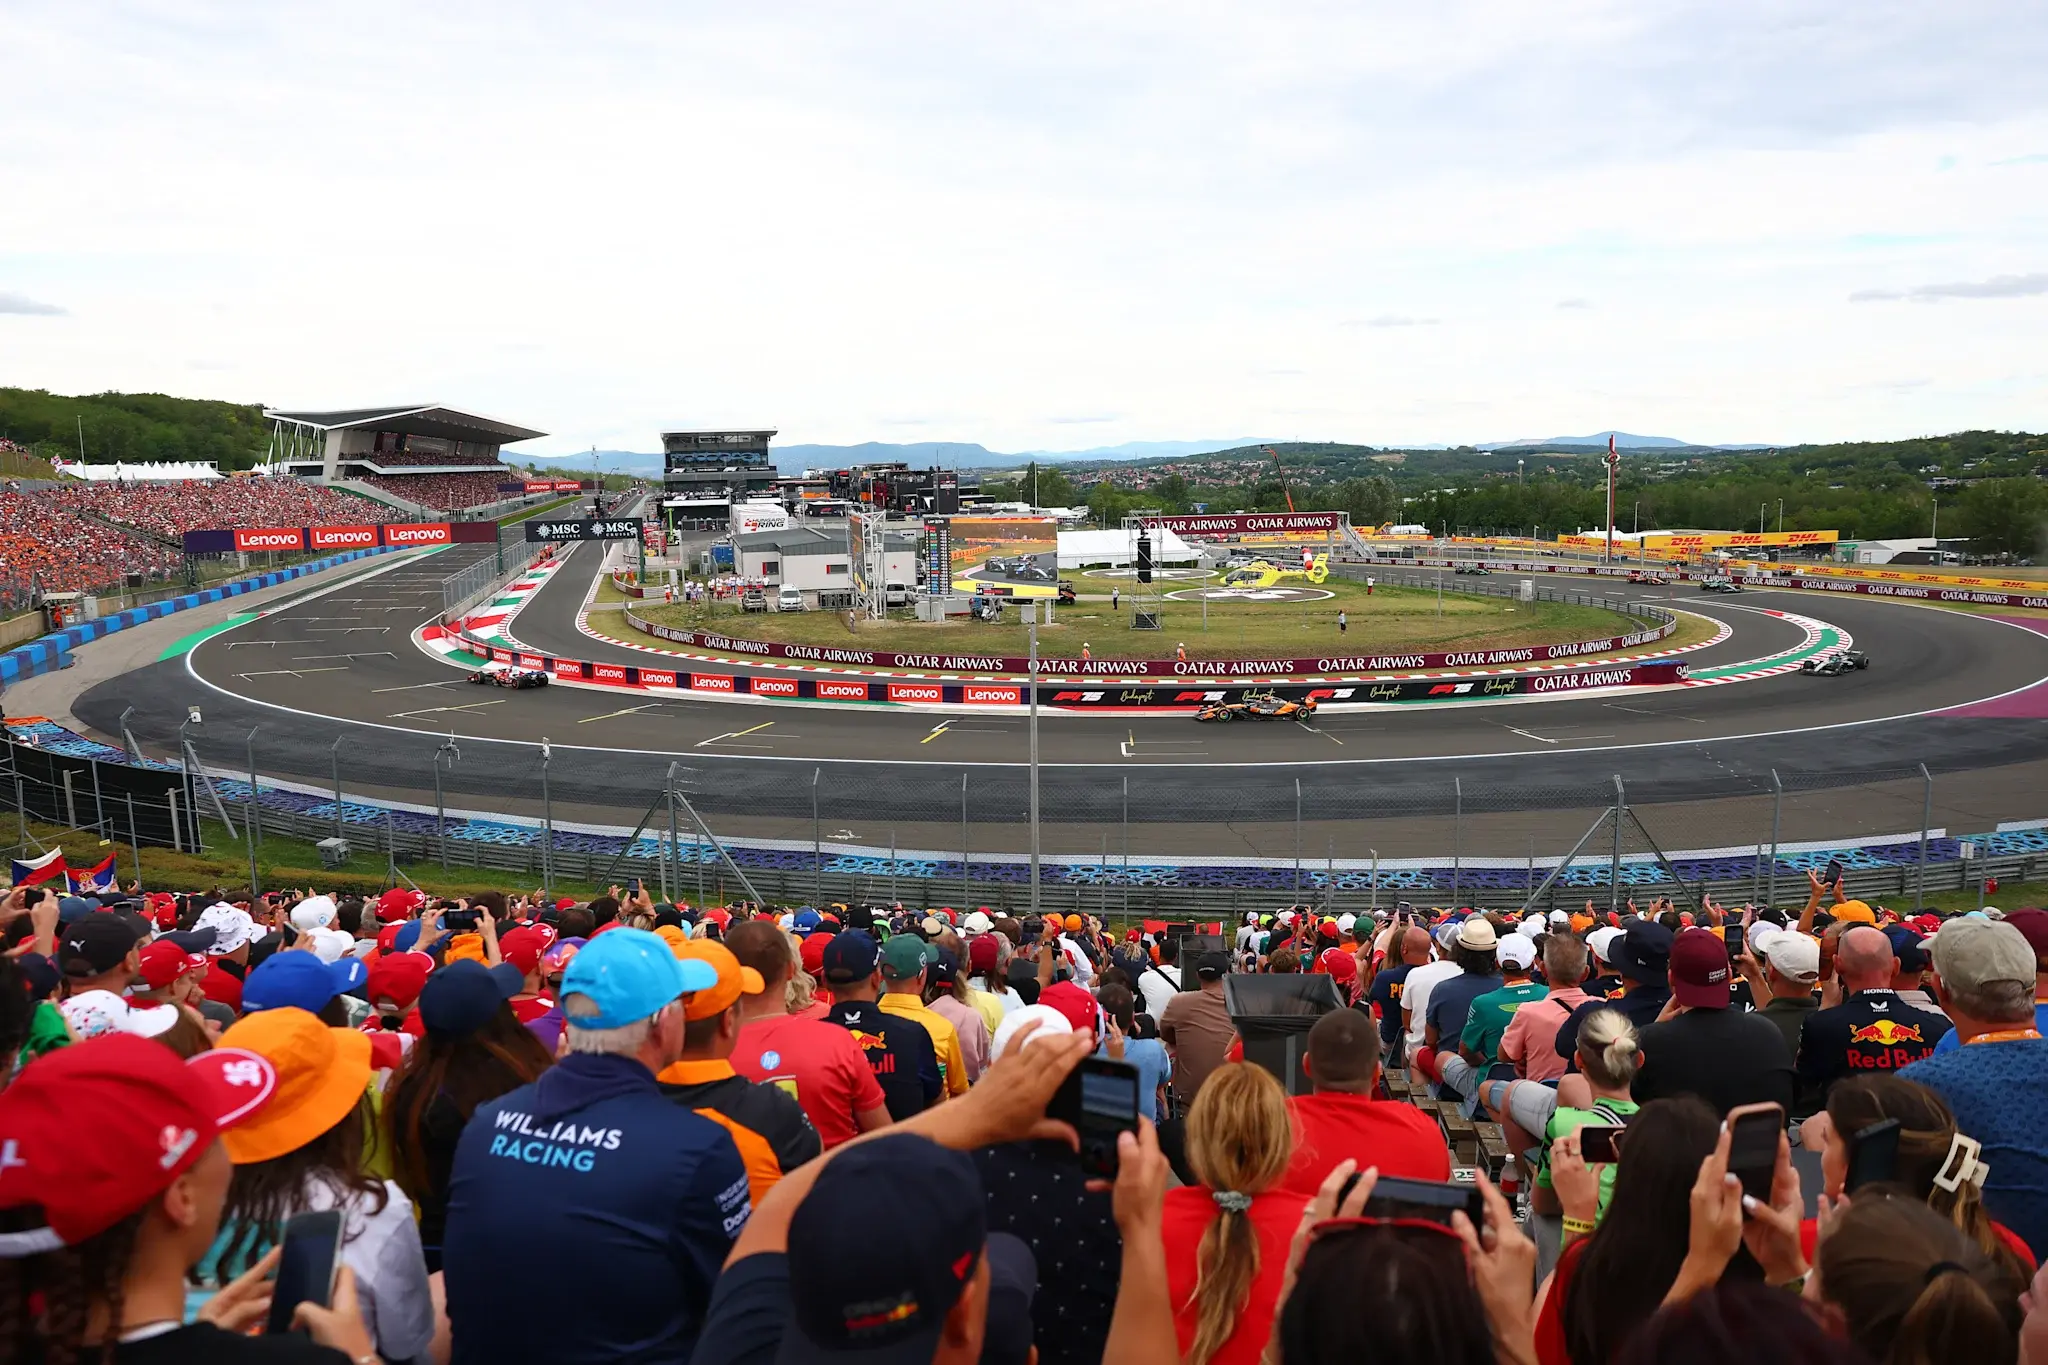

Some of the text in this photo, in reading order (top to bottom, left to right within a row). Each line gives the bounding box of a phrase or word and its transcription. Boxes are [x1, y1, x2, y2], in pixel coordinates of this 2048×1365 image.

[526, 483, 550, 491] Lenovo
[555, 482, 579, 490] Lenovo
[551, 523, 580, 534] MSC
[605, 521, 634, 533] MSC
[1149, 519, 1237, 531] QATAR AIRWAYS
[1246, 516, 1332, 530] QATAR AIRWAYS
[240, 533, 298, 546] Lenovo
[315, 531, 373, 544] Lenovo
[389, 528, 446, 542] Lenovo
[1566, 537, 1587, 545] DHL
[1671, 537, 1704, 546] DHL
[1730, 535, 1762, 545] DHL
[1788, 533, 1819, 542] DHL
[1742, 576, 1792, 587] QATAR AIRWAYS
[1801, 580, 1857, 592] QATAR AIRWAYS
[1868, 585, 1928, 598] QATAR AIRWAYS
[1941, 591, 2008, 604] QATAR AIRWAYS
[652, 626, 695, 644] QATAR AIRWAYS
[704, 636, 770, 655] QATAR AIRWAYS
[1548, 639, 1612, 658] QATAR AIRWAYS
[493, 651, 511, 662] Lenovo
[785, 645, 874, 664] QATAR AIRWAYS
[1445, 649, 1533, 666] QATAR AIRWAYS
[521, 655, 542, 668] Lenovo
[555, 661, 580, 674] Lenovo
[894, 654, 1003, 670] QATAR AIRWAYS
[1027, 660, 1148, 674] QATAR AIRWAYS
[1174, 660, 1294, 675] QATAR AIRWAYS
[1318, 655, 1425, 672] QATAR AIRWAYS
[595, 666, 624, 679] Lenovo
[641, 671, 673, 684] Lenovo
[694, 676, 731, 689] Lenovo
[754, 680, 794, 693] Lenovo
[1484, 677, 1517, 696] Budapest
[1534, 669, 1632, 692] QATAR AIRWAYS
[820, 684, 864, 696] Lenovo
[892, 687, 938, 699] Lenovo
[968, 689, 1016, 701] Lenovo
[1369, 684, 1402, 700] Budapest
[1120, 689, 1155, 705] Budapest
[762, 1052, 778, 1069] hp
[869, 1053, 896, 1075] ull
[1847, 1047, 1892, 1069] Red
[489, 1134, 597, 1172] RACING
